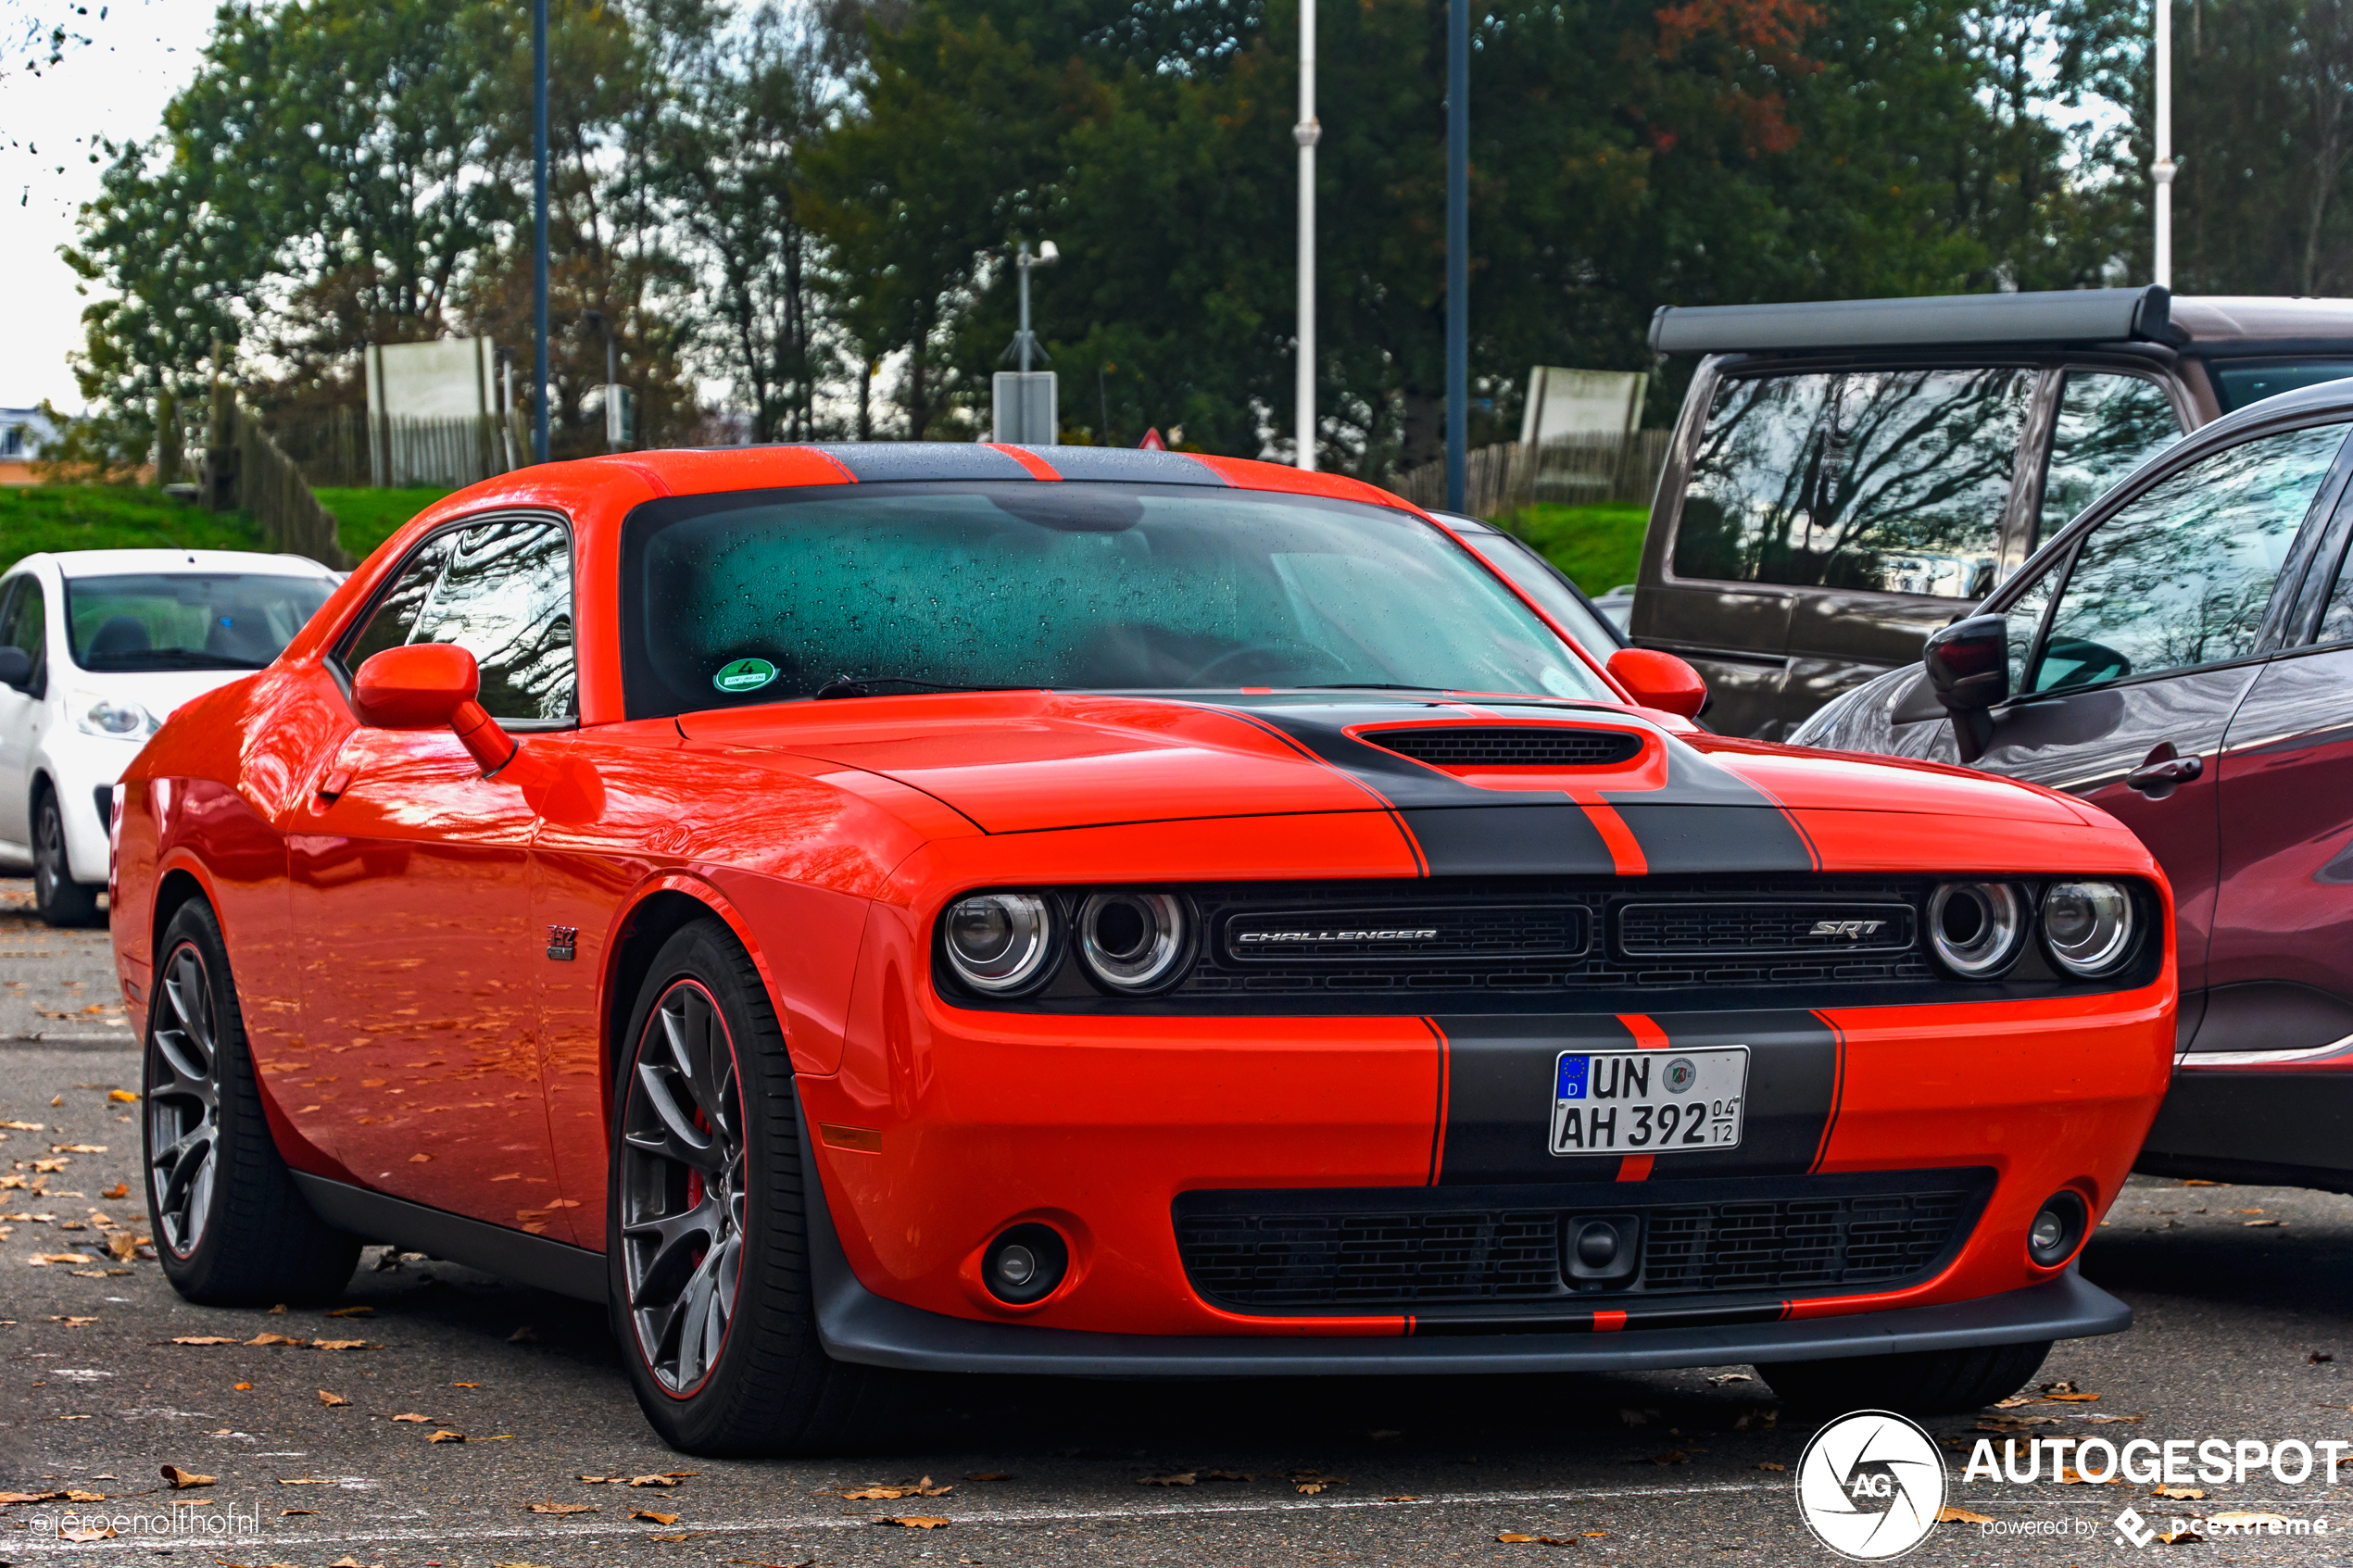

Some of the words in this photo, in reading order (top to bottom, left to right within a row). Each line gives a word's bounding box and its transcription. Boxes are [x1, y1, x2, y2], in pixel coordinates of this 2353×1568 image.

[737, 660, 754, 674] 4
[1239, 930, 1437, 942] CHALLENGER
[1809, 921, 1888, 939] SRT
[1592, 1056, 1651, 1099] UN
[1567, 1083, 1579, 1096] D
[1713, 1098, 1735, 1117] 04
[1559, 1106, 1617, 1148] AH
[1628, 1101, 1707, 1147] 392
[1713, 1123, 1733, 1142] 12
